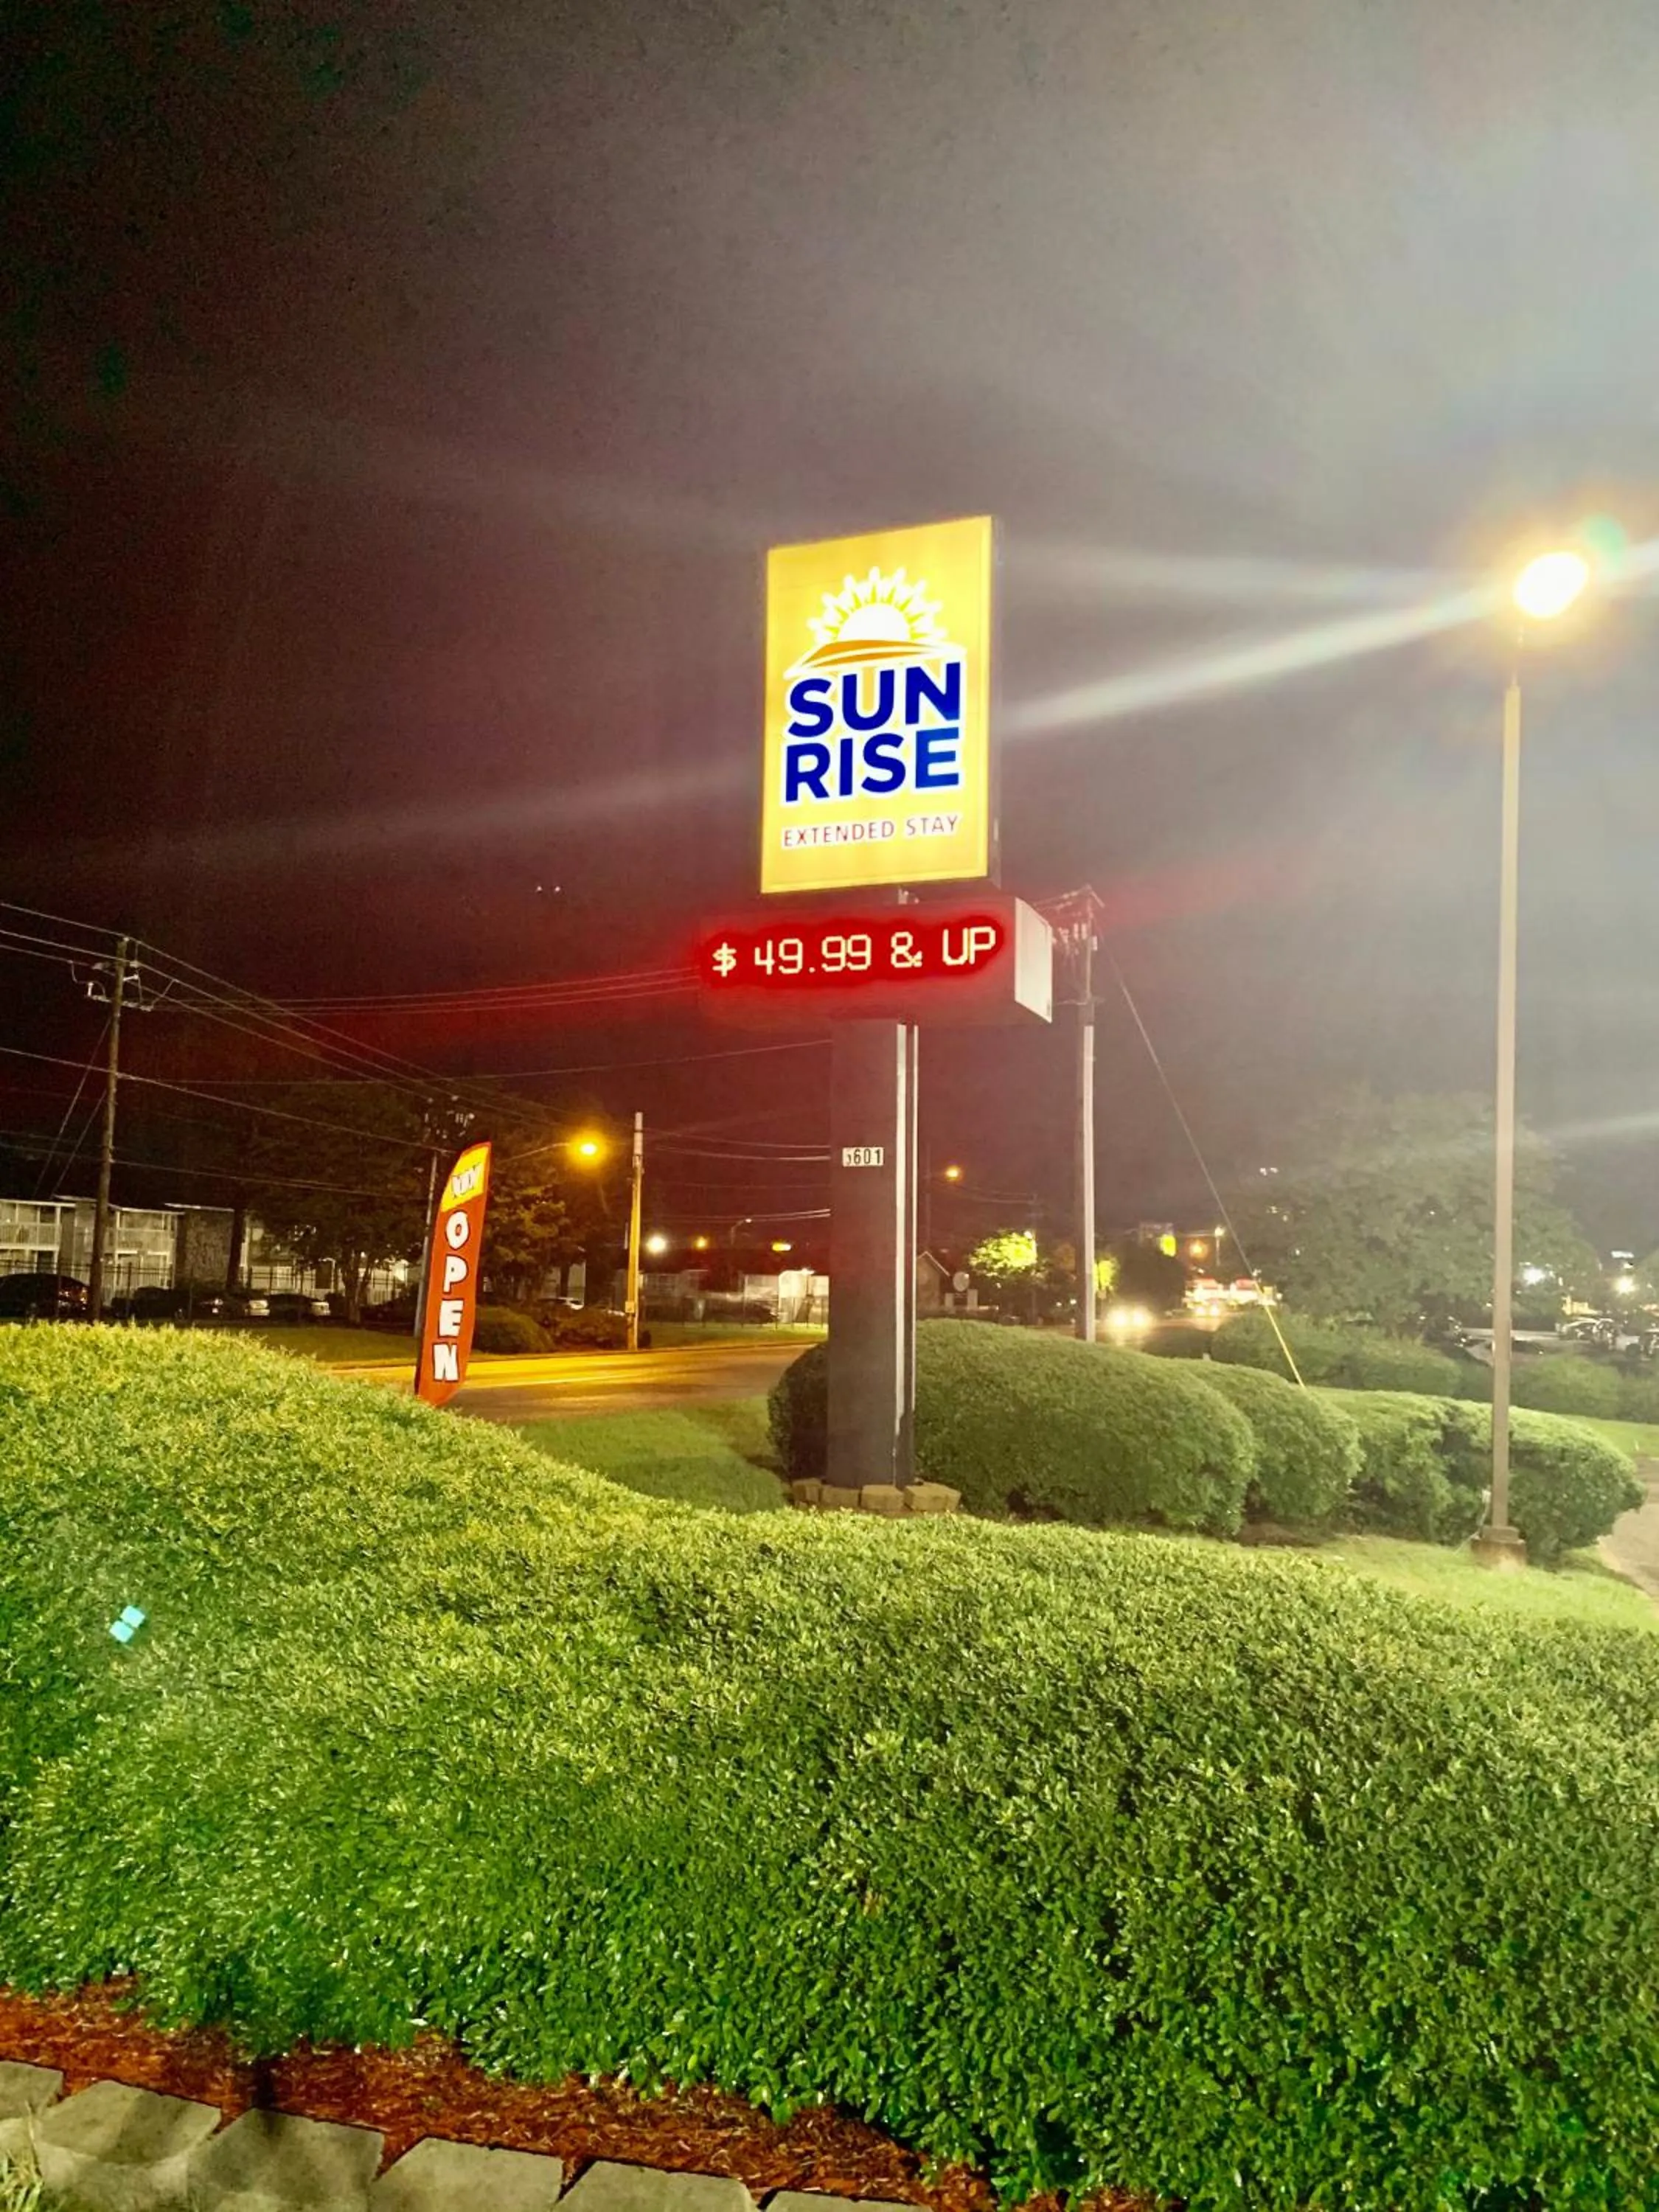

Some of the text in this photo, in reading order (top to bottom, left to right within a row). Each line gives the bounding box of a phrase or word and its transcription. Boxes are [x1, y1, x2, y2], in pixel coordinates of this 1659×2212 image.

[789, 662, 961, 738] SUN
[784, 727, 960, 803] RISE
[784, 815, 959, 847] EXTENDED STAY
[712, 925, 996, 977] $ 49.99 & UP
[433, 1210, 469, 1382] OPEN
